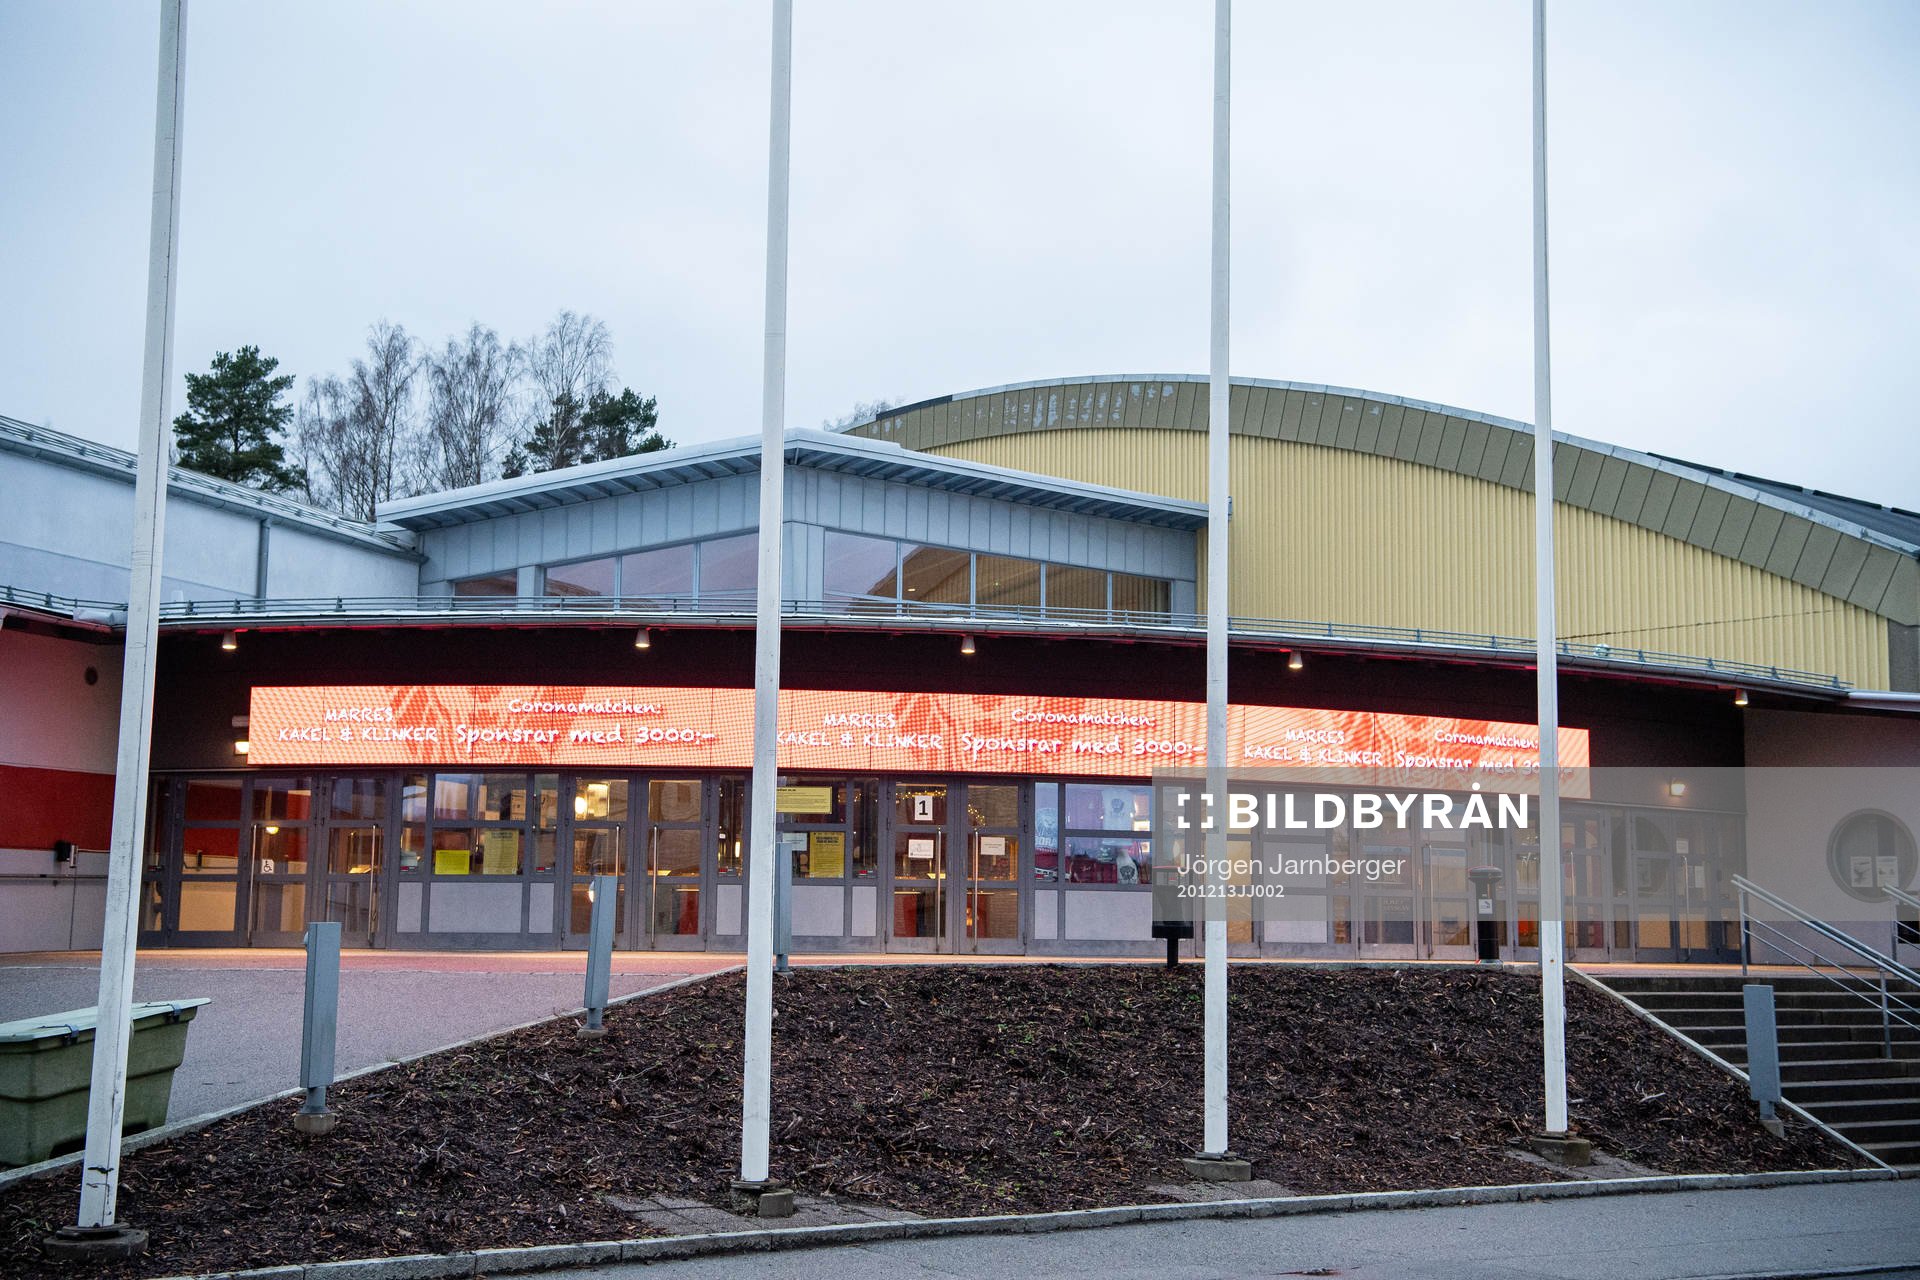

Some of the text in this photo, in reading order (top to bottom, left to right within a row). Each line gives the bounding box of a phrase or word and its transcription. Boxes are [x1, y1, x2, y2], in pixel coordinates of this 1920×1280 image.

[325, 706, 393, 722] MARRES
[508, 699, 662, 714] Coronamatchen:
[824, 713, 896, 728] MARRES
[1012, 709, 1156, 727] Coronamatchen:
[278, 727, 332, 741] KAKEL
[362, 727, 438, 742] KLINKER
[456, 724, 559, 753] Sponsrar
[570, 724, 625, 743] med
[864, 733, 943, 750] KLINKER
[1285, 728, 1345, 744] MARRES
[1434, 729, 1539, 749] Coronamatchen:
[961, 733, 1062, 762] Sponsrar
[1072, 735, 1122, 754] med
[1244, 744, 1293, 761] KAKEL
[1319, 748, 1383, 766] KLINKER
[1479, 756, 1517, 774] med
[918, 800, 929, 816] 1
